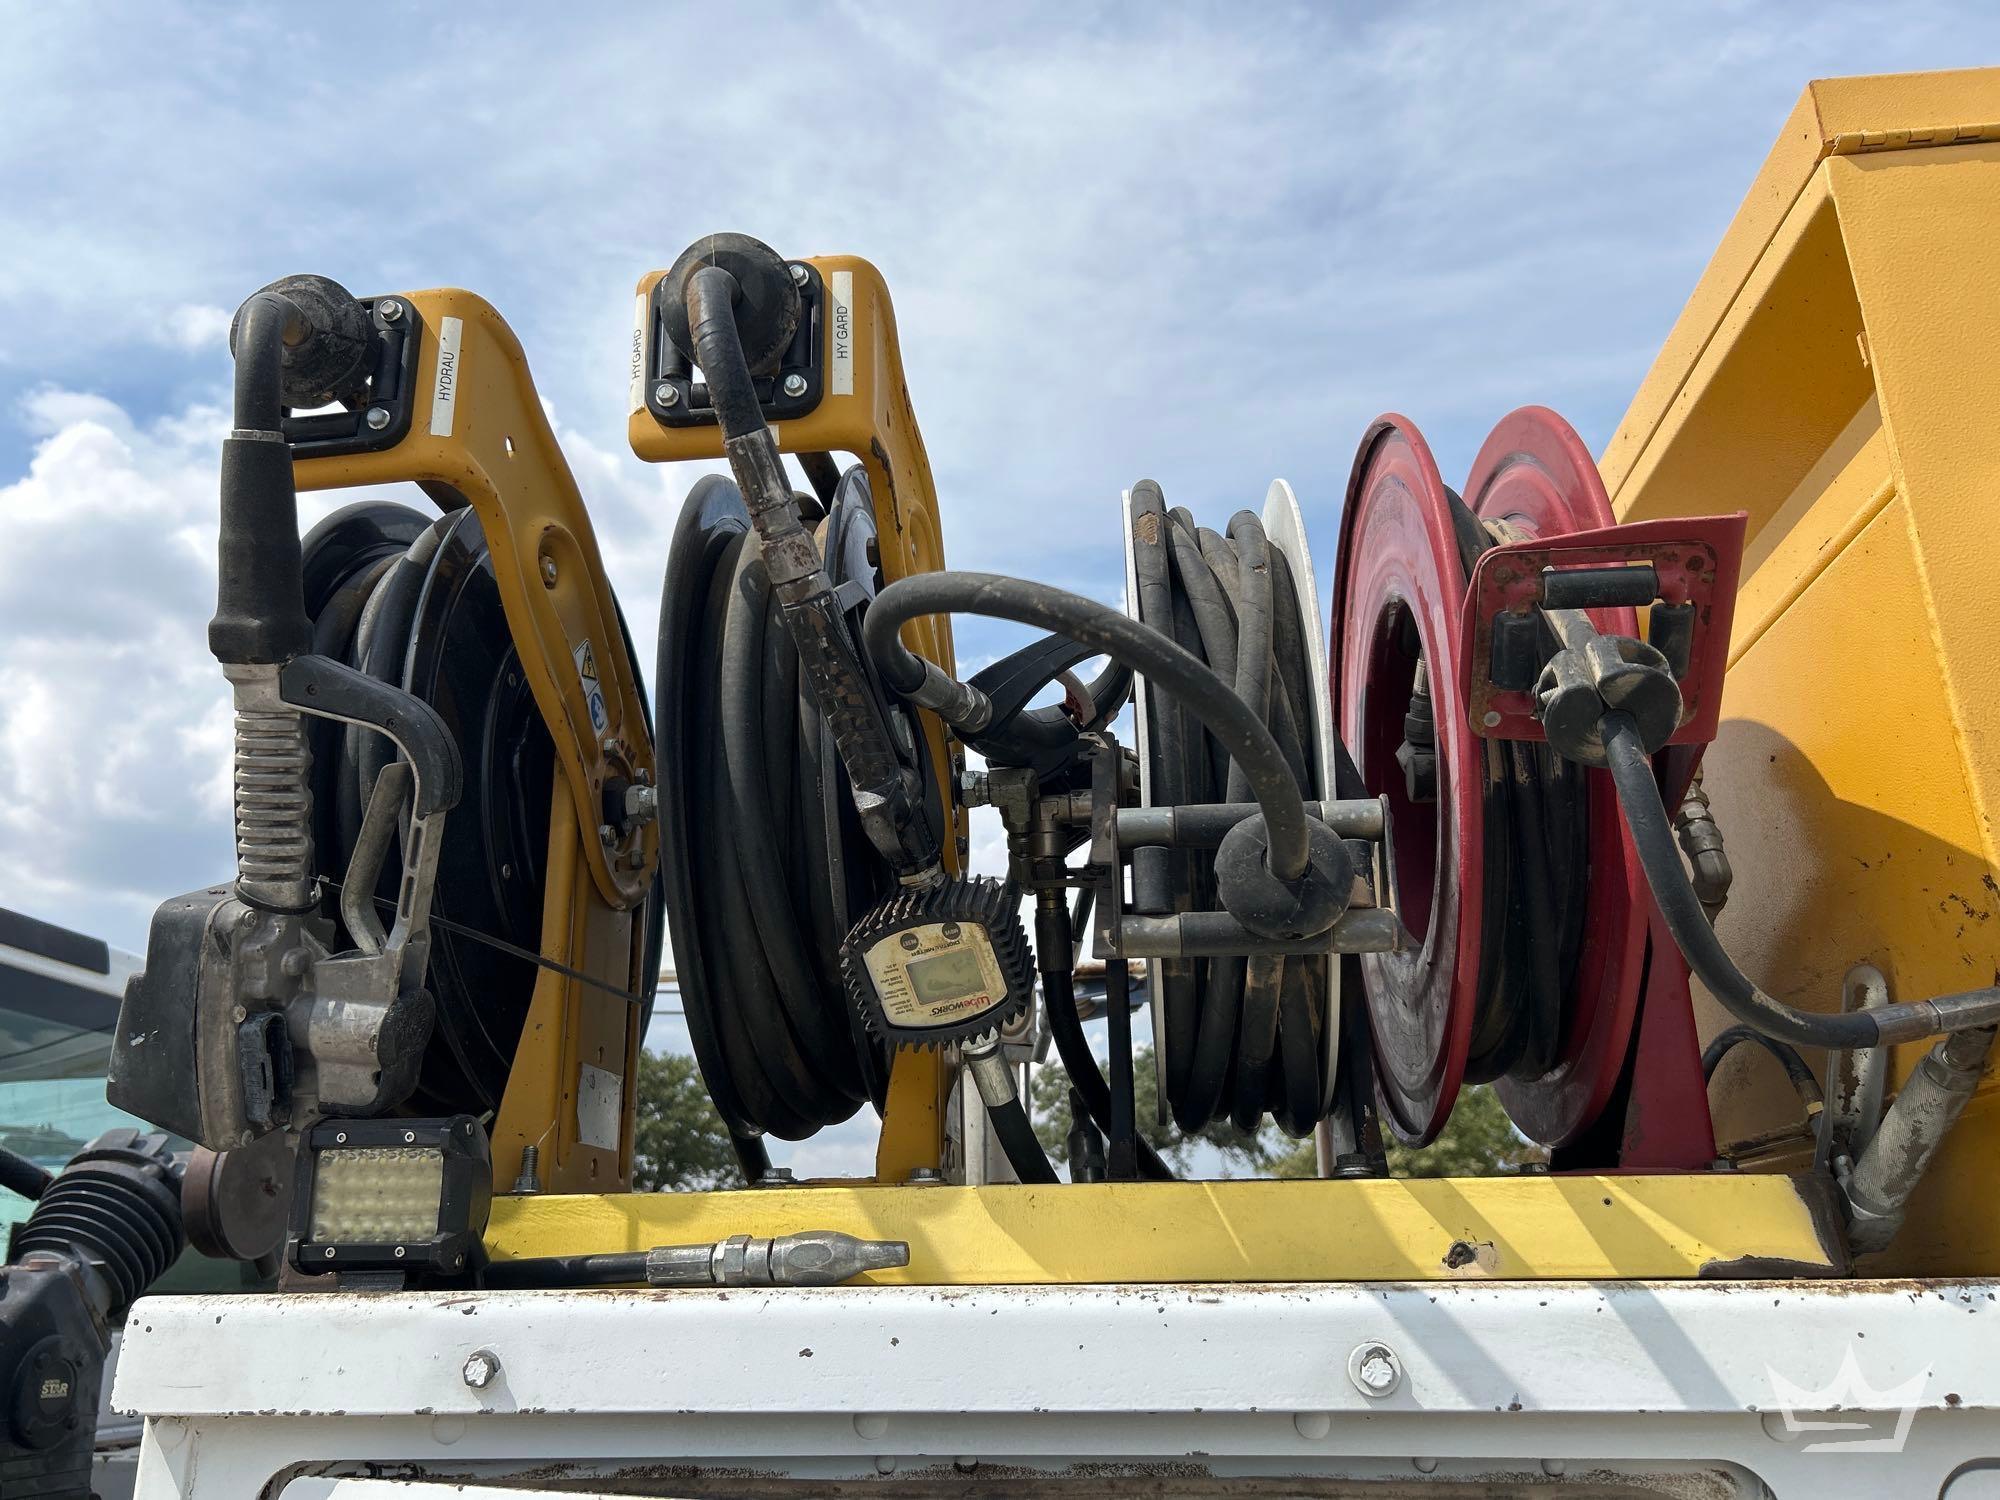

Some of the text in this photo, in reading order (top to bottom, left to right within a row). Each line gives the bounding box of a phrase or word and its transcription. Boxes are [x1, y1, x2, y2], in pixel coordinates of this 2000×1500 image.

[836, 306, 848, 359] HY GARD
[438, 351, 455, 401] HYDRAU
[911, 946, 935, 956] METER
[41, 1382, 69, 1394] STAR
